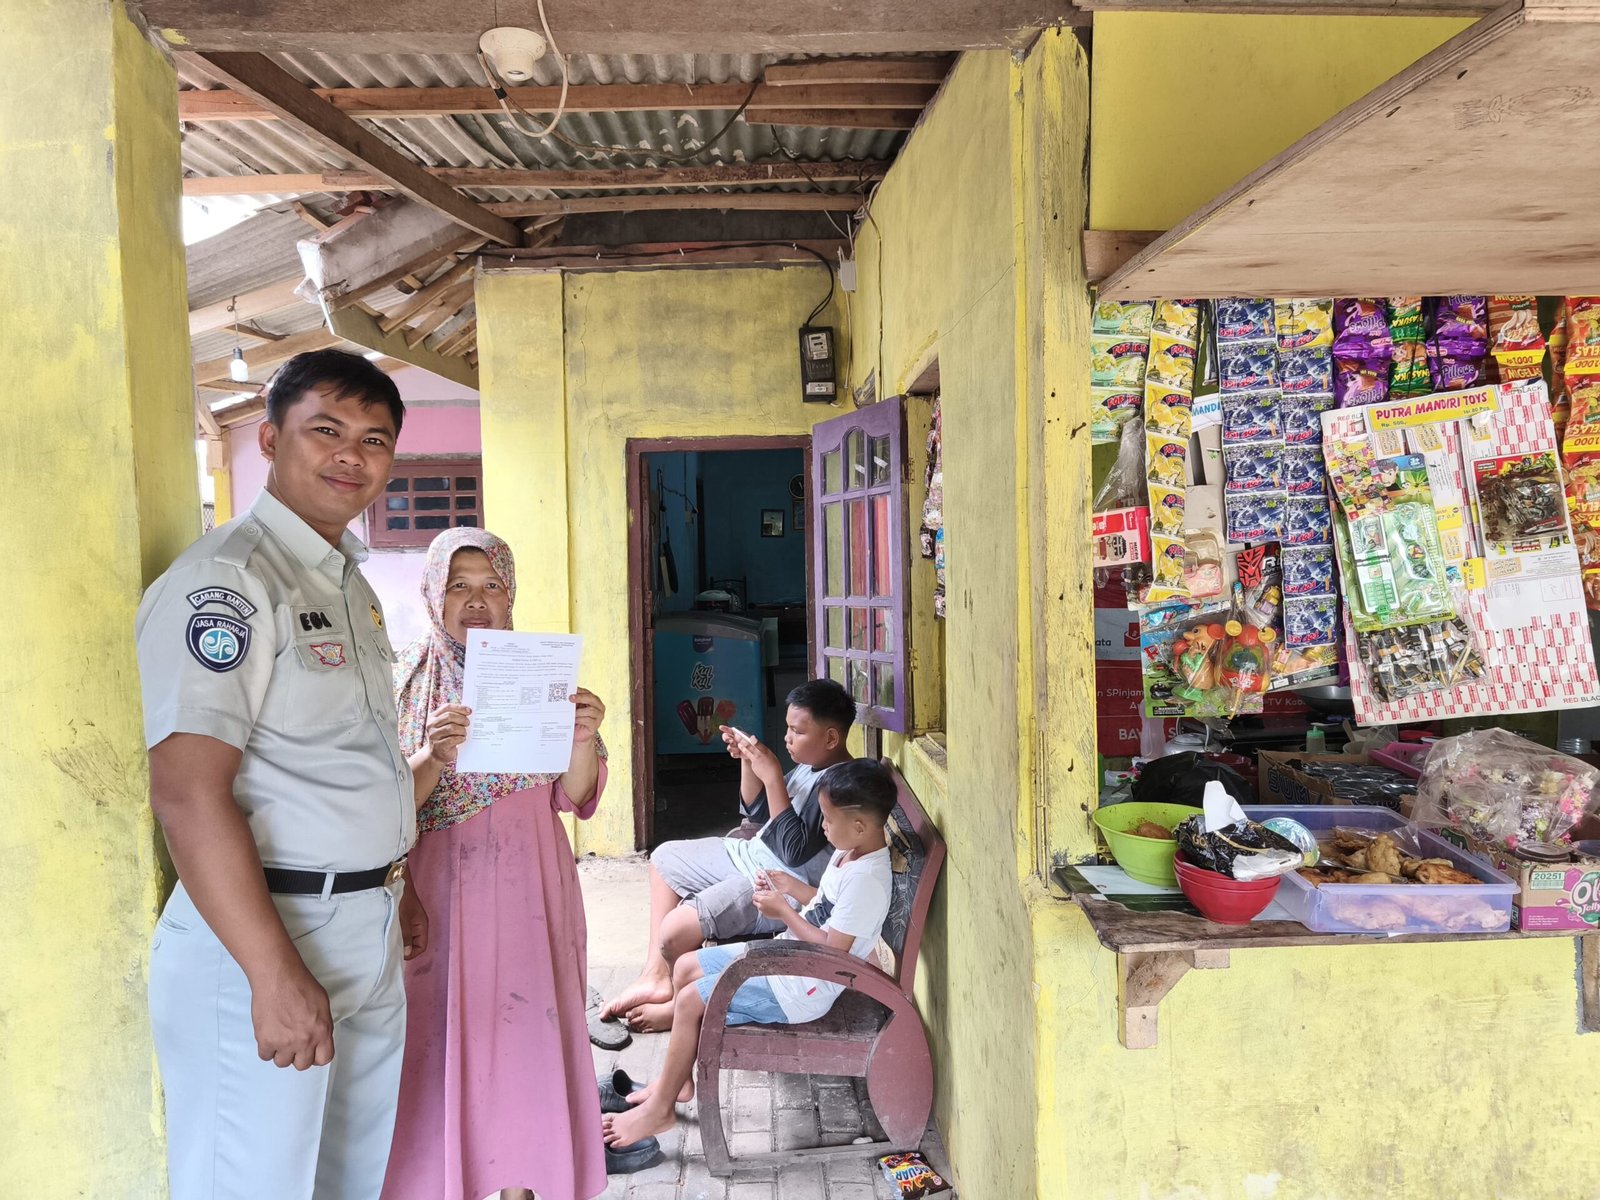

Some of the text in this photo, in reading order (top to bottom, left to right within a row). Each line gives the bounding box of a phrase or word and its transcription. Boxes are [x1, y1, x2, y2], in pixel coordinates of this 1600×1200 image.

[1376, 392, 1488, 420] PUTRA MANDIRI TOYS
[194, 591, 252, 616] CABANG BANTEN
[194, 617, 247, 640] JASA RAHARJA
[1534, 872, 1562, 880] 20251
